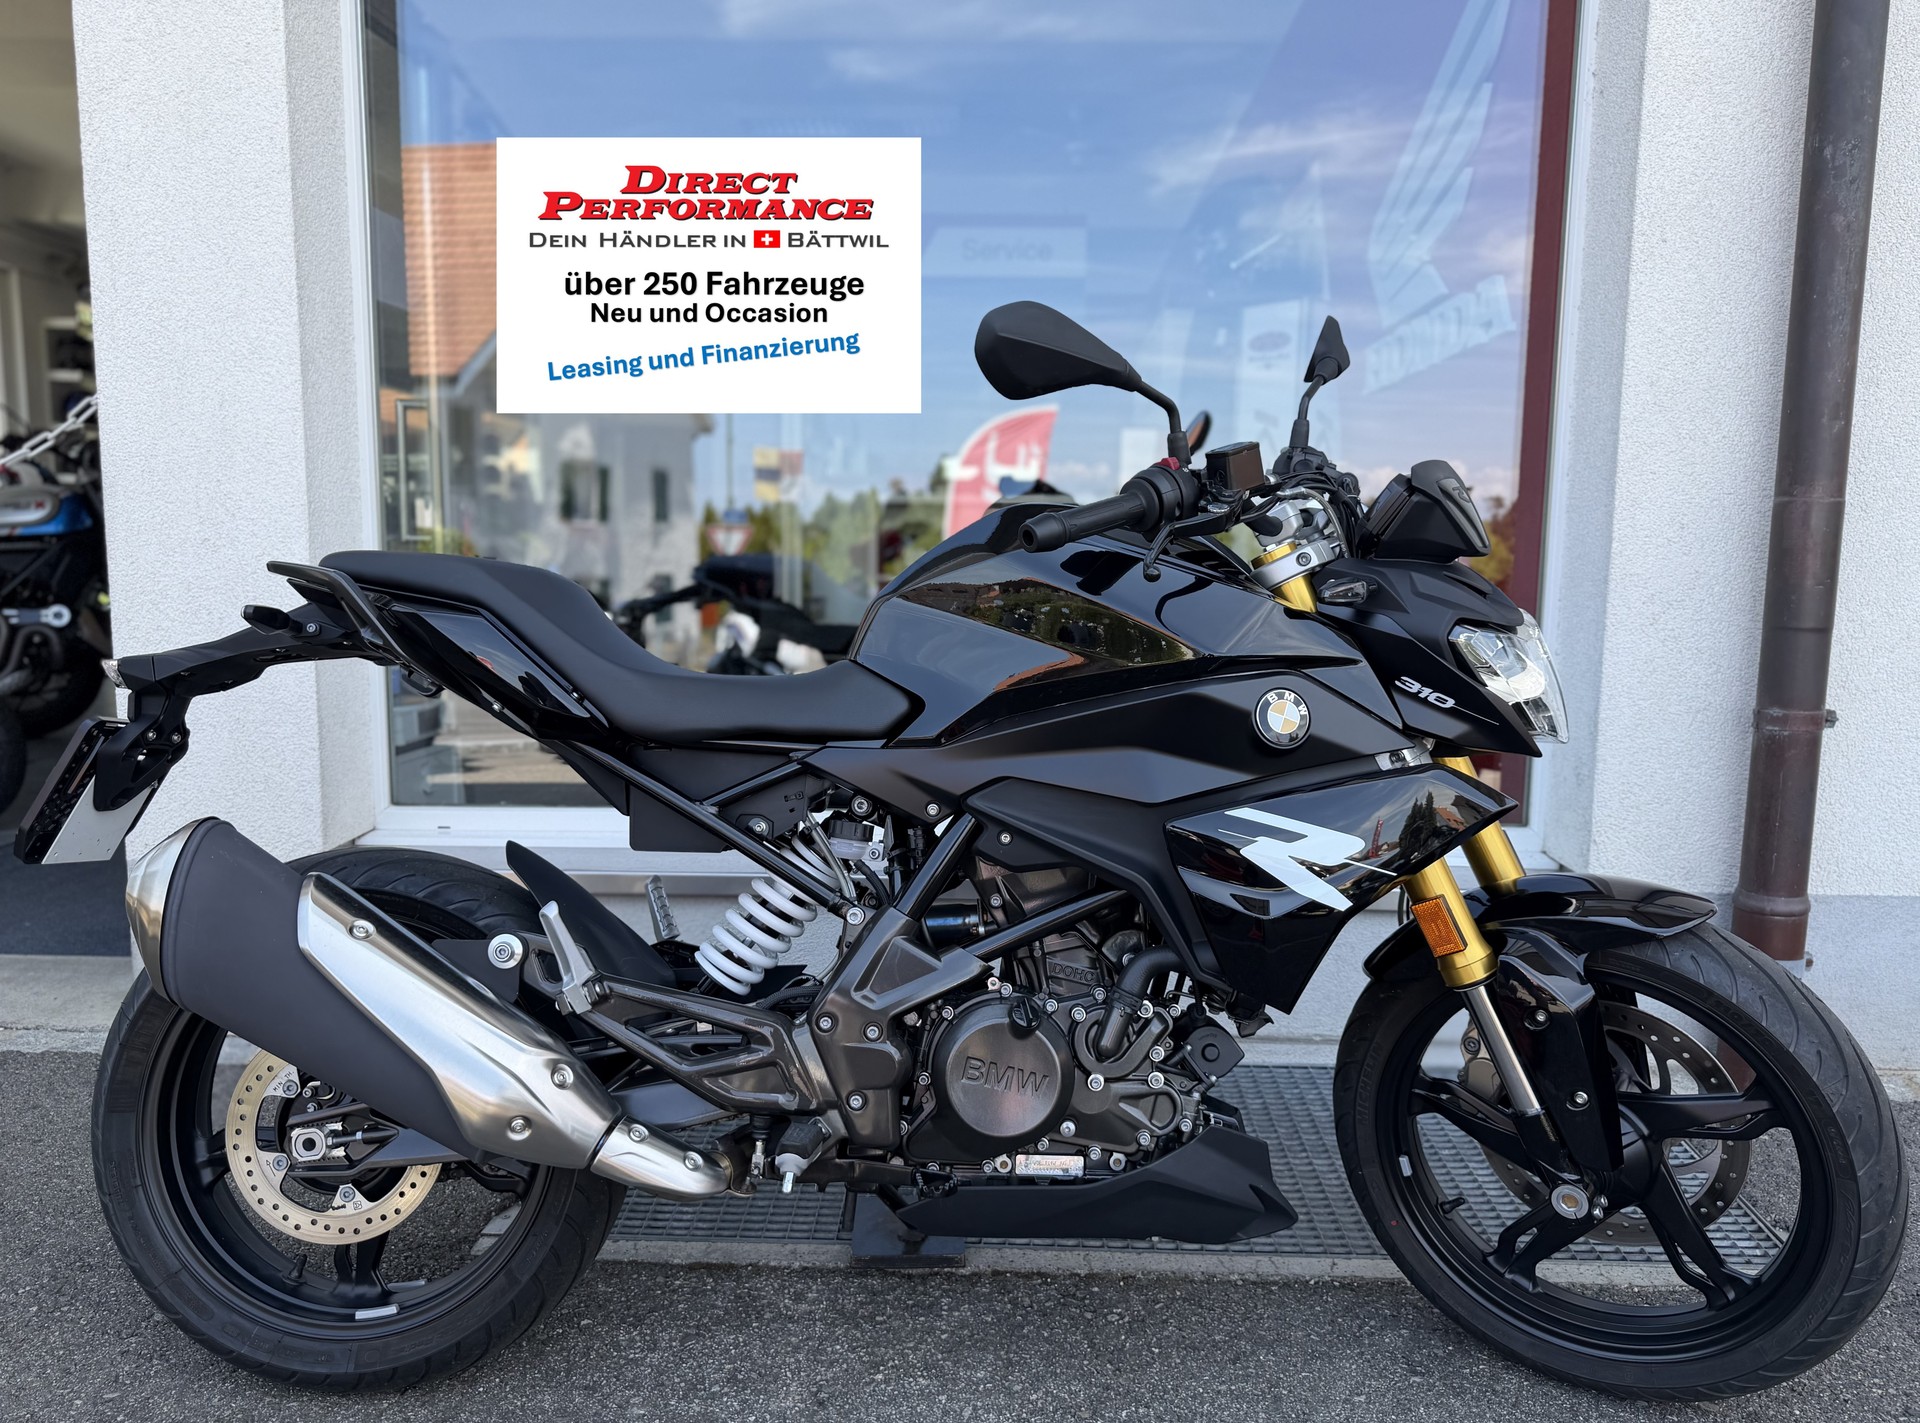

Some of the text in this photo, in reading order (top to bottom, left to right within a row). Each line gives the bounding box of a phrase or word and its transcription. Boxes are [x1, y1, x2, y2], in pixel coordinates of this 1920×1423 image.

[1267, 692, 1308, 715] BMW
[1394, 676, 1456, 708] 310
[1052, 963, 1096, 981] DOHC
[961, 1056, 1049, 1098] BMW
